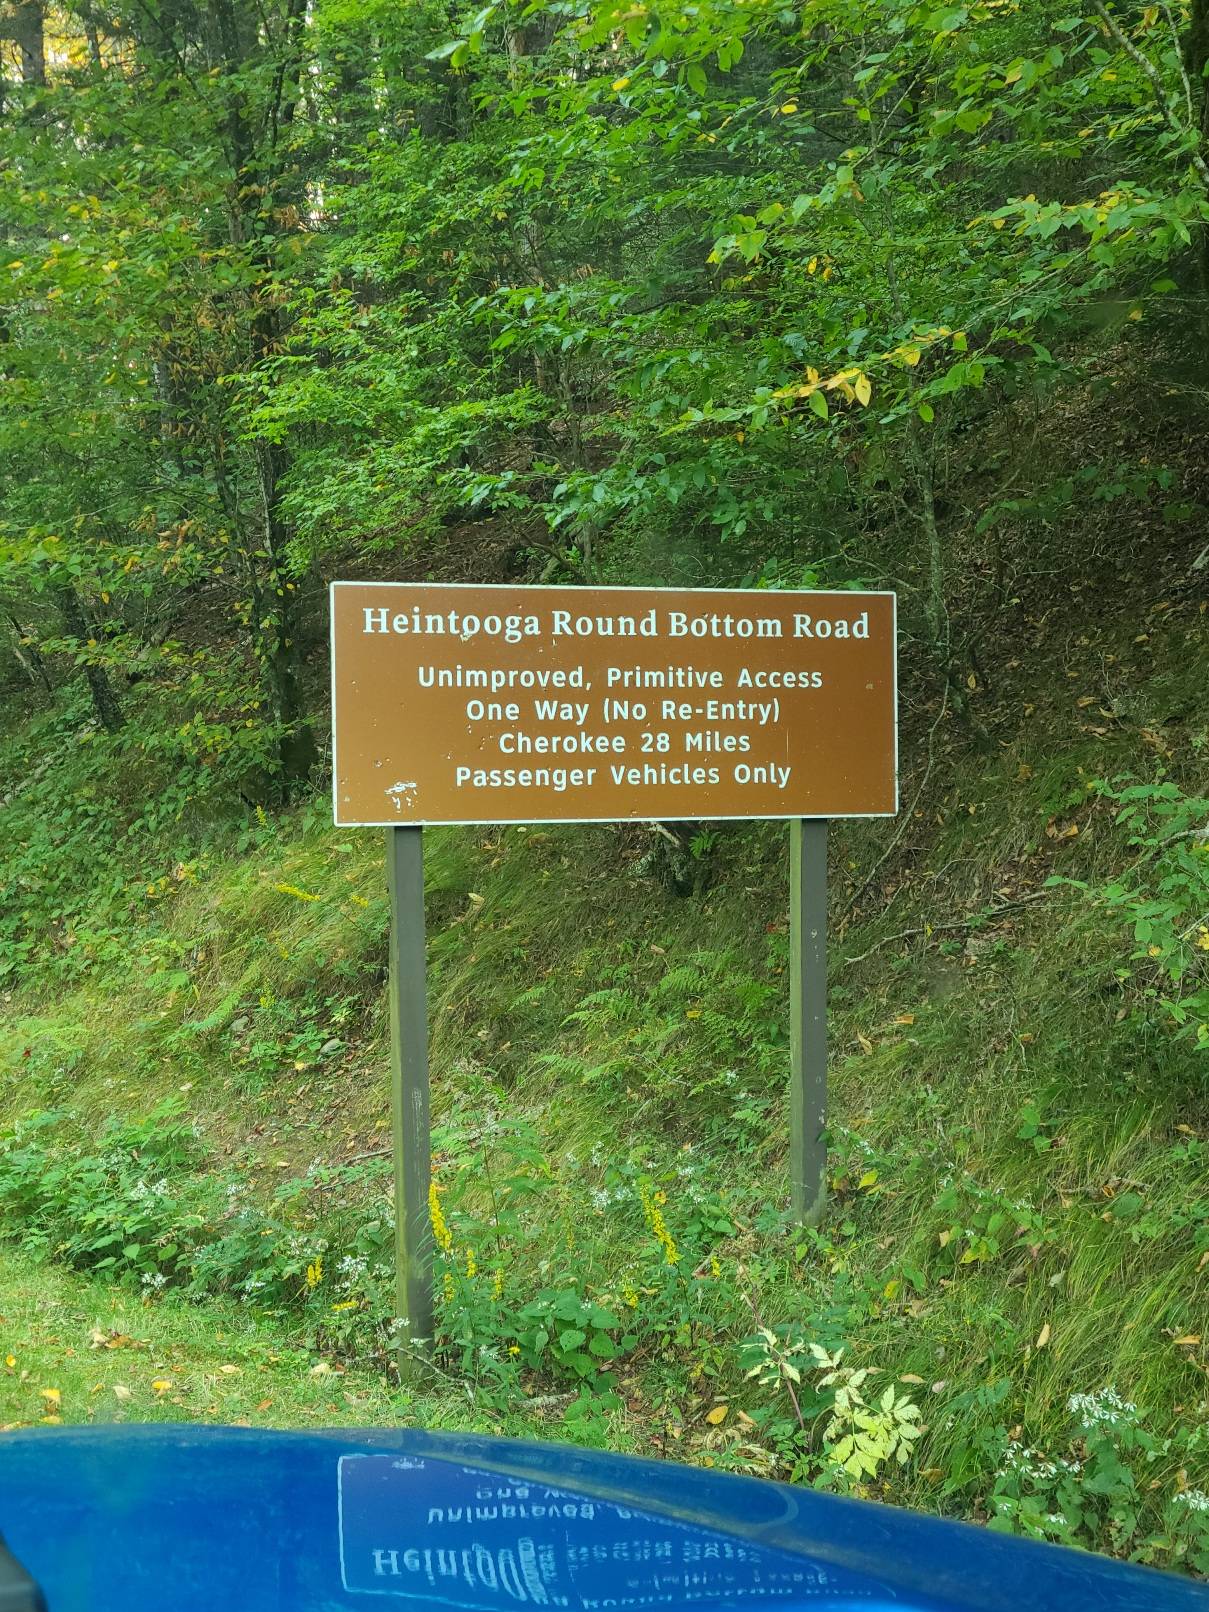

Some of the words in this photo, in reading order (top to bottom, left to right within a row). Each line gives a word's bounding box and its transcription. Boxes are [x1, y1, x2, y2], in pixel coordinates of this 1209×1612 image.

[362, 606, 542, 644] Heintooga
[551, 609, 659, 637] Round
[668, 611, 784, 638] Bottom
[792, 612, 870, 639] Road
[418, 664, 592, 693] Unimproved,
[607, 665, 724, 688] Primitive
[737, 668, 823, 688] Access
[466, 700, 520, 721] One
[534, 700, 590, 726] Way
[603, 698, 648, 724] (No
[661, 697, 780, 725] Re-Entry)
[499, 731, 626, 754] Cherokee
[640, 732, 671, 752] 28
[685, 730, 751, 752] Miles
[456, 766, 597, 792] Passenger
[610, 761, 720, 785] Vehicles
[734, 763, 792, 789] Only
